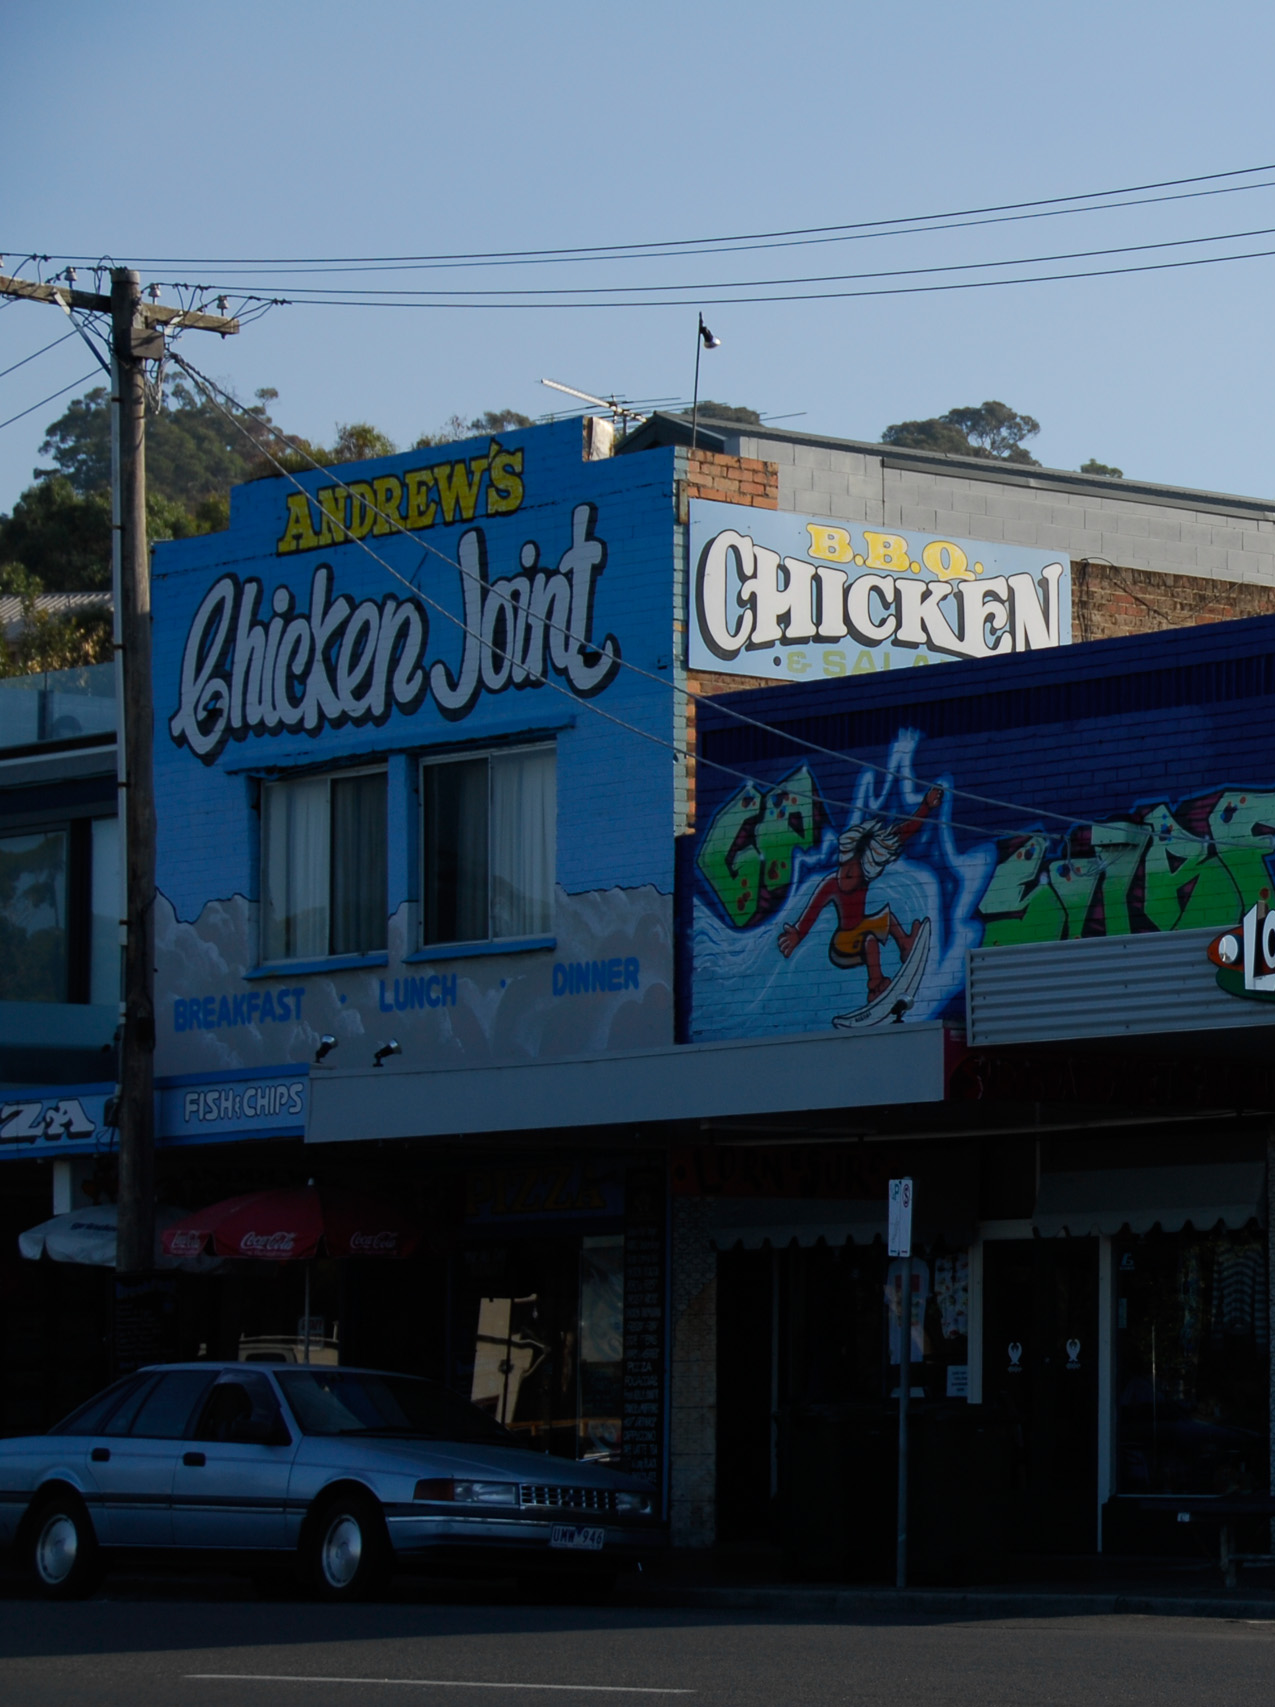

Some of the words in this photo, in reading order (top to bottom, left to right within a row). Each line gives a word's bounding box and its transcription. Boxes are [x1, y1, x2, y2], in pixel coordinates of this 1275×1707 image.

[277, 438, 524, 556] ANDREW'S
[807, 522, 984, 582] B.B.Q.
[698, 529, 1063, 660] CHICKEN
[170, 564, 428, 762] Chicken
[430, 502, 621, 721] Joint
[787, 652, 812, 674] &
[380, 974, 456, 1013] LUNCH
[553, 957, 640, 995] DINNER
[174, 988, 305, 1032] BREAKFAST
[463, 1164, 606, 1216] PIZZA
